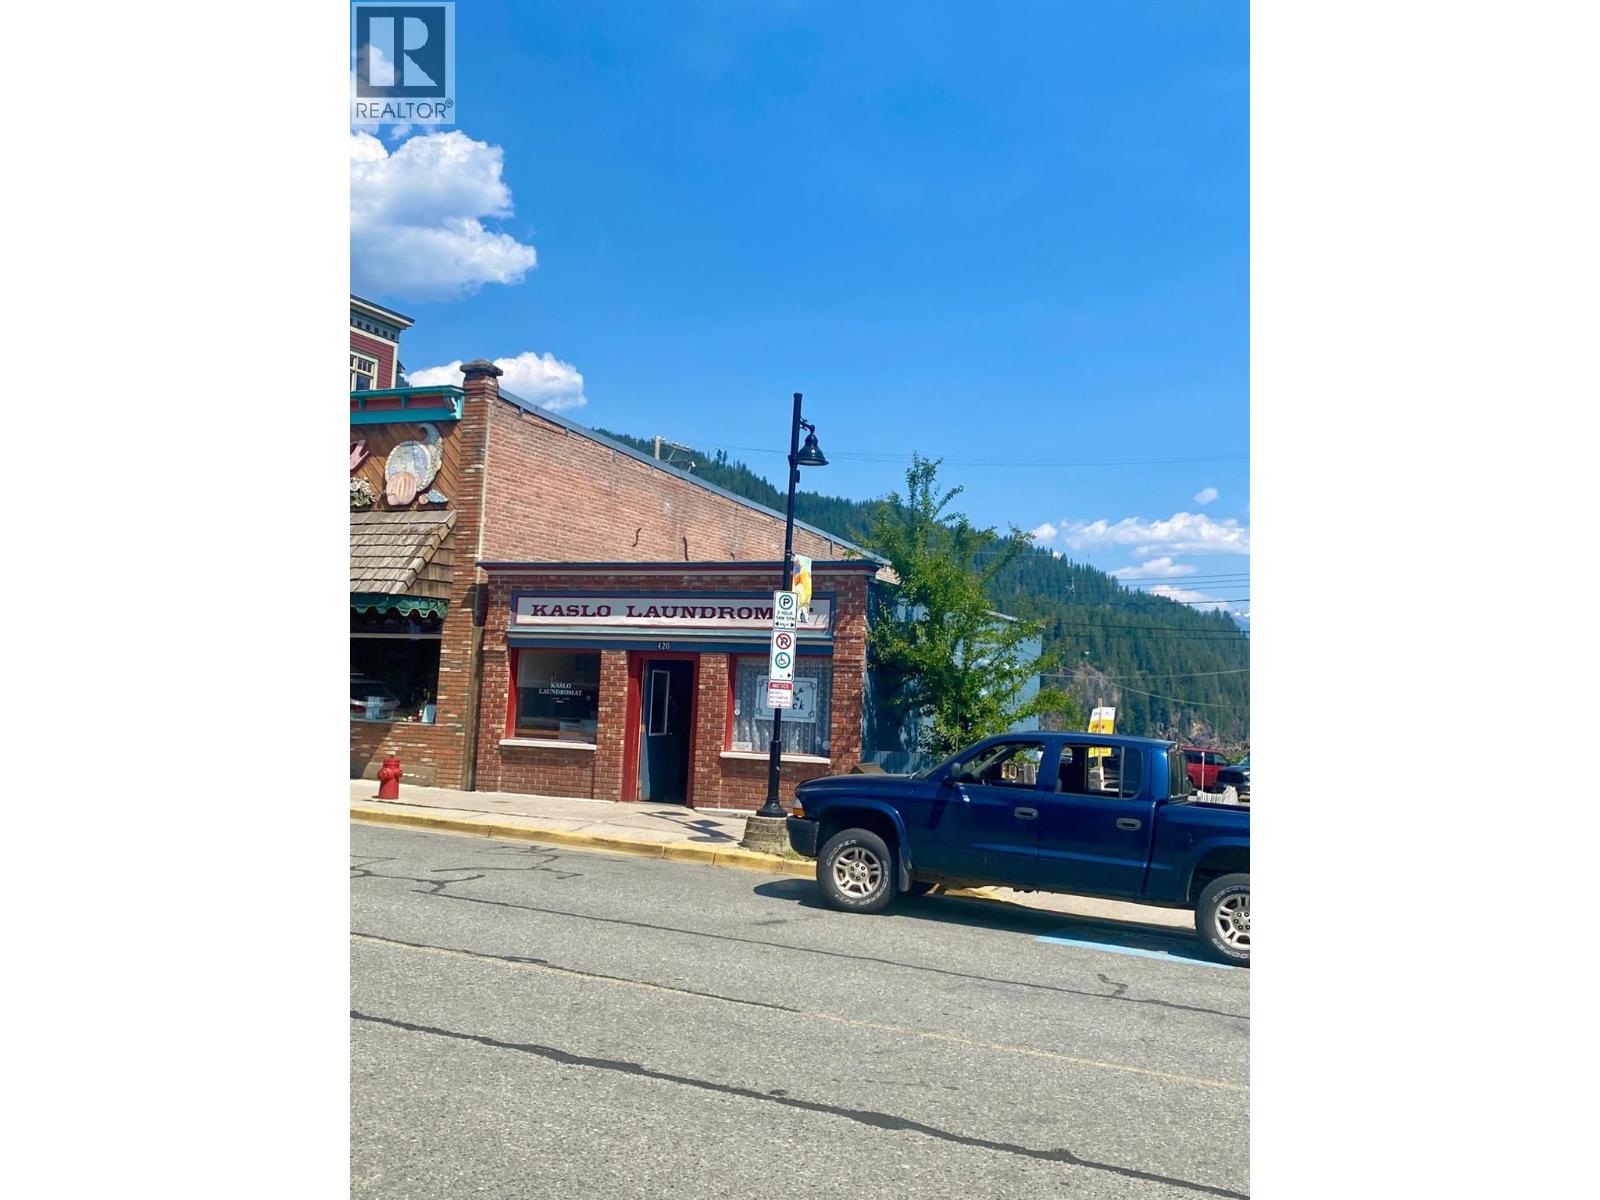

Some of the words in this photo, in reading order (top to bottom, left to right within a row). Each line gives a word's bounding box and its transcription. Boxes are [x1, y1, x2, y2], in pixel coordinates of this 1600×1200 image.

[783, 597, 790, 606] P
[531, 604, 611, 618] KASLO
[626, 605, 814, 620] LAUNDROM
[657, 642, 670, 650] 420
[550, 681, 572, 689] KASLO
[538, 688, 583, 696] LAUNDROMAT
